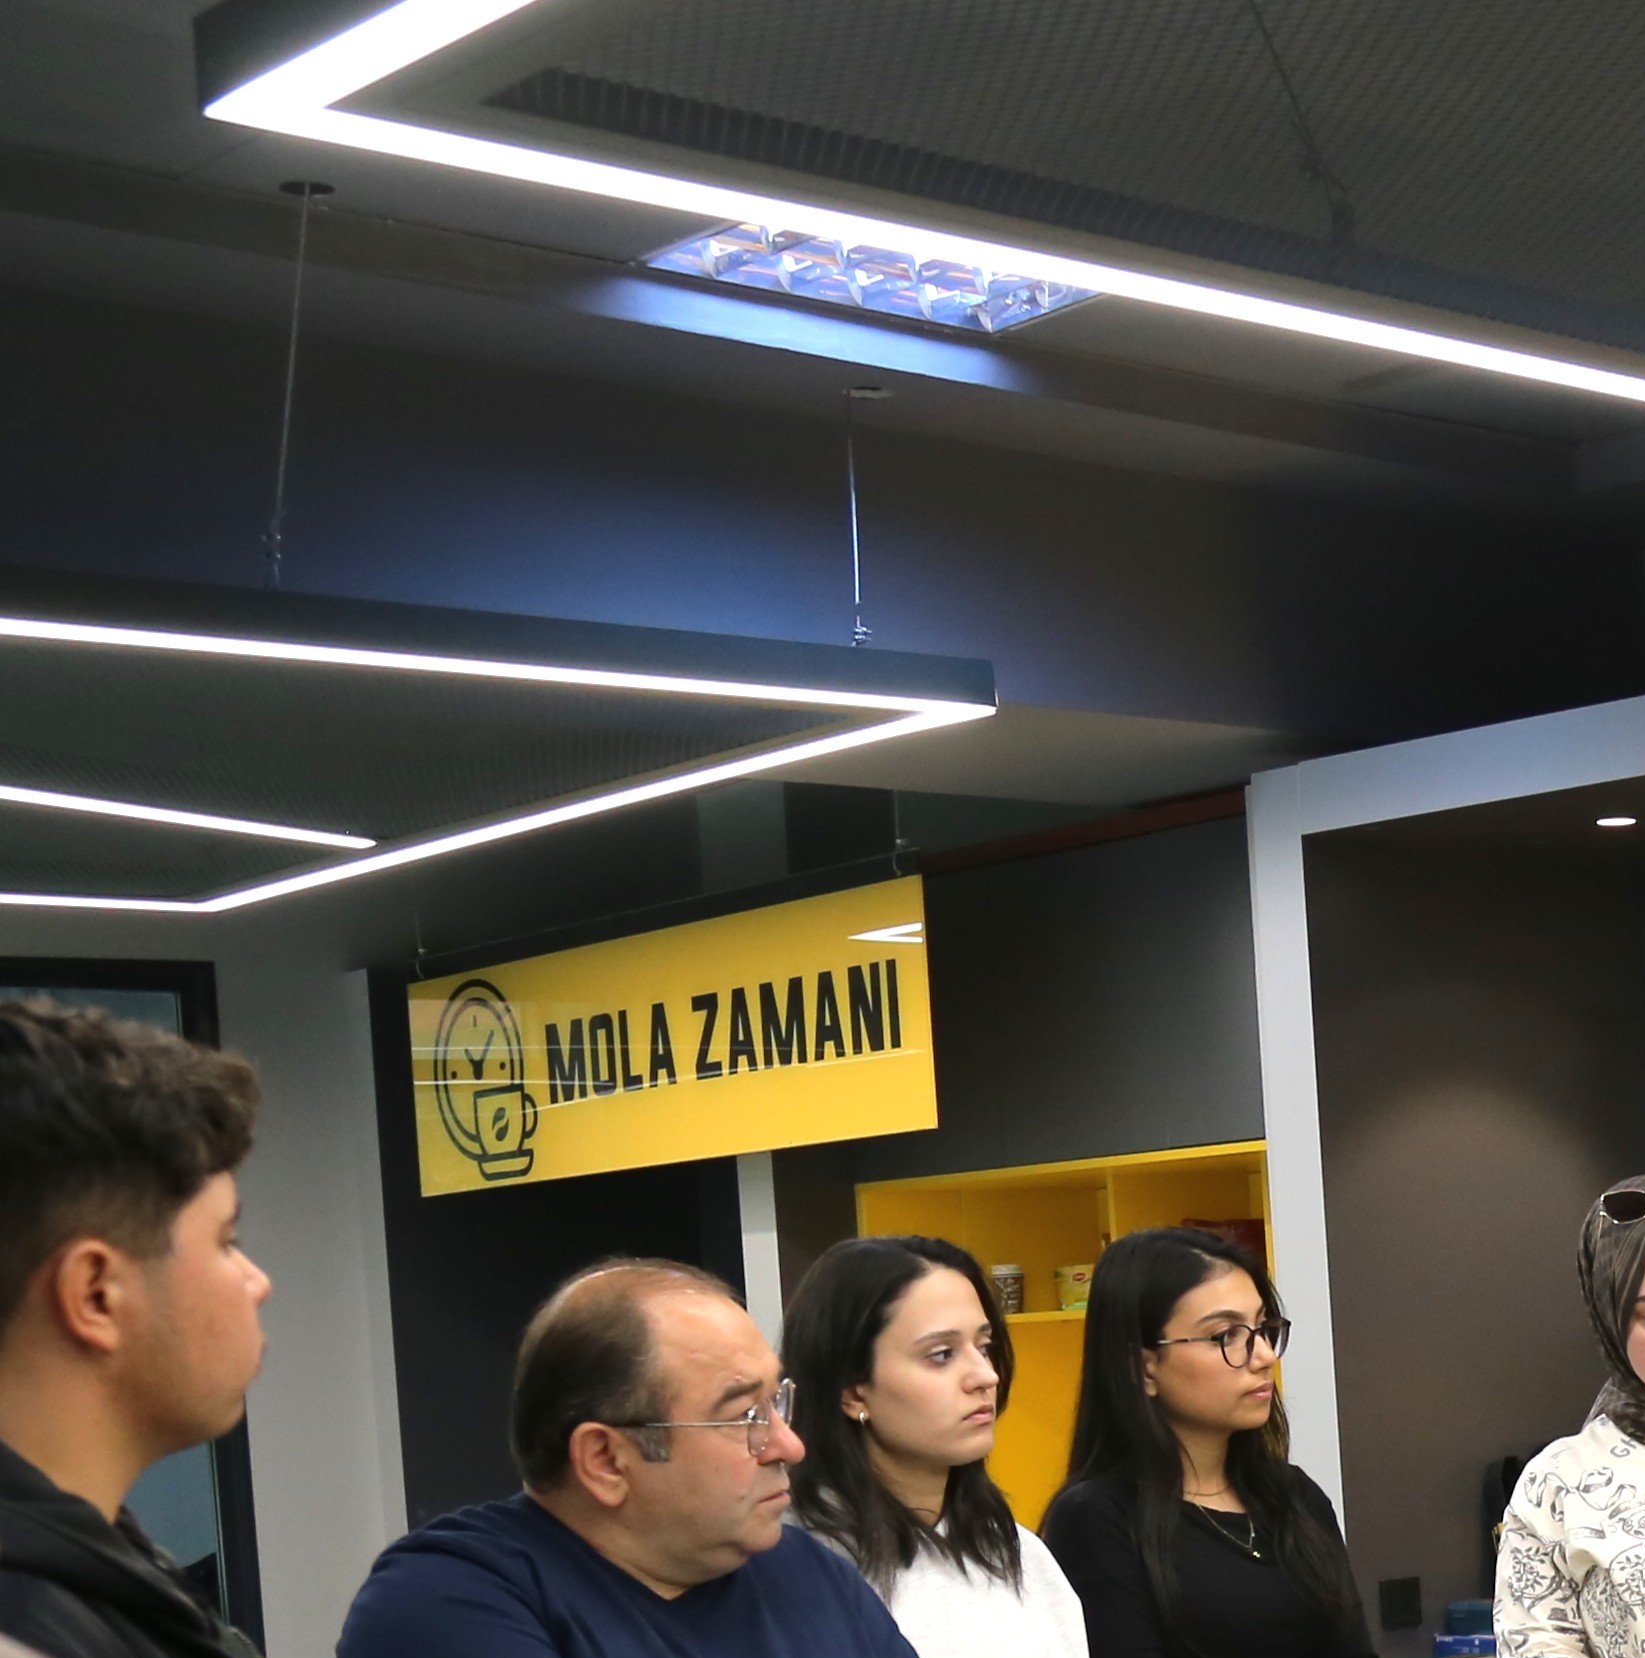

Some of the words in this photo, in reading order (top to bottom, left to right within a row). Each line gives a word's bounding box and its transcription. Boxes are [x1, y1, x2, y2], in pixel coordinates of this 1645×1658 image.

[545, 1002, 676, 1105] MOLA
[691, 958, 901, 1080] ZAMANI
[1610, 1436, 1638, 1459] GH
